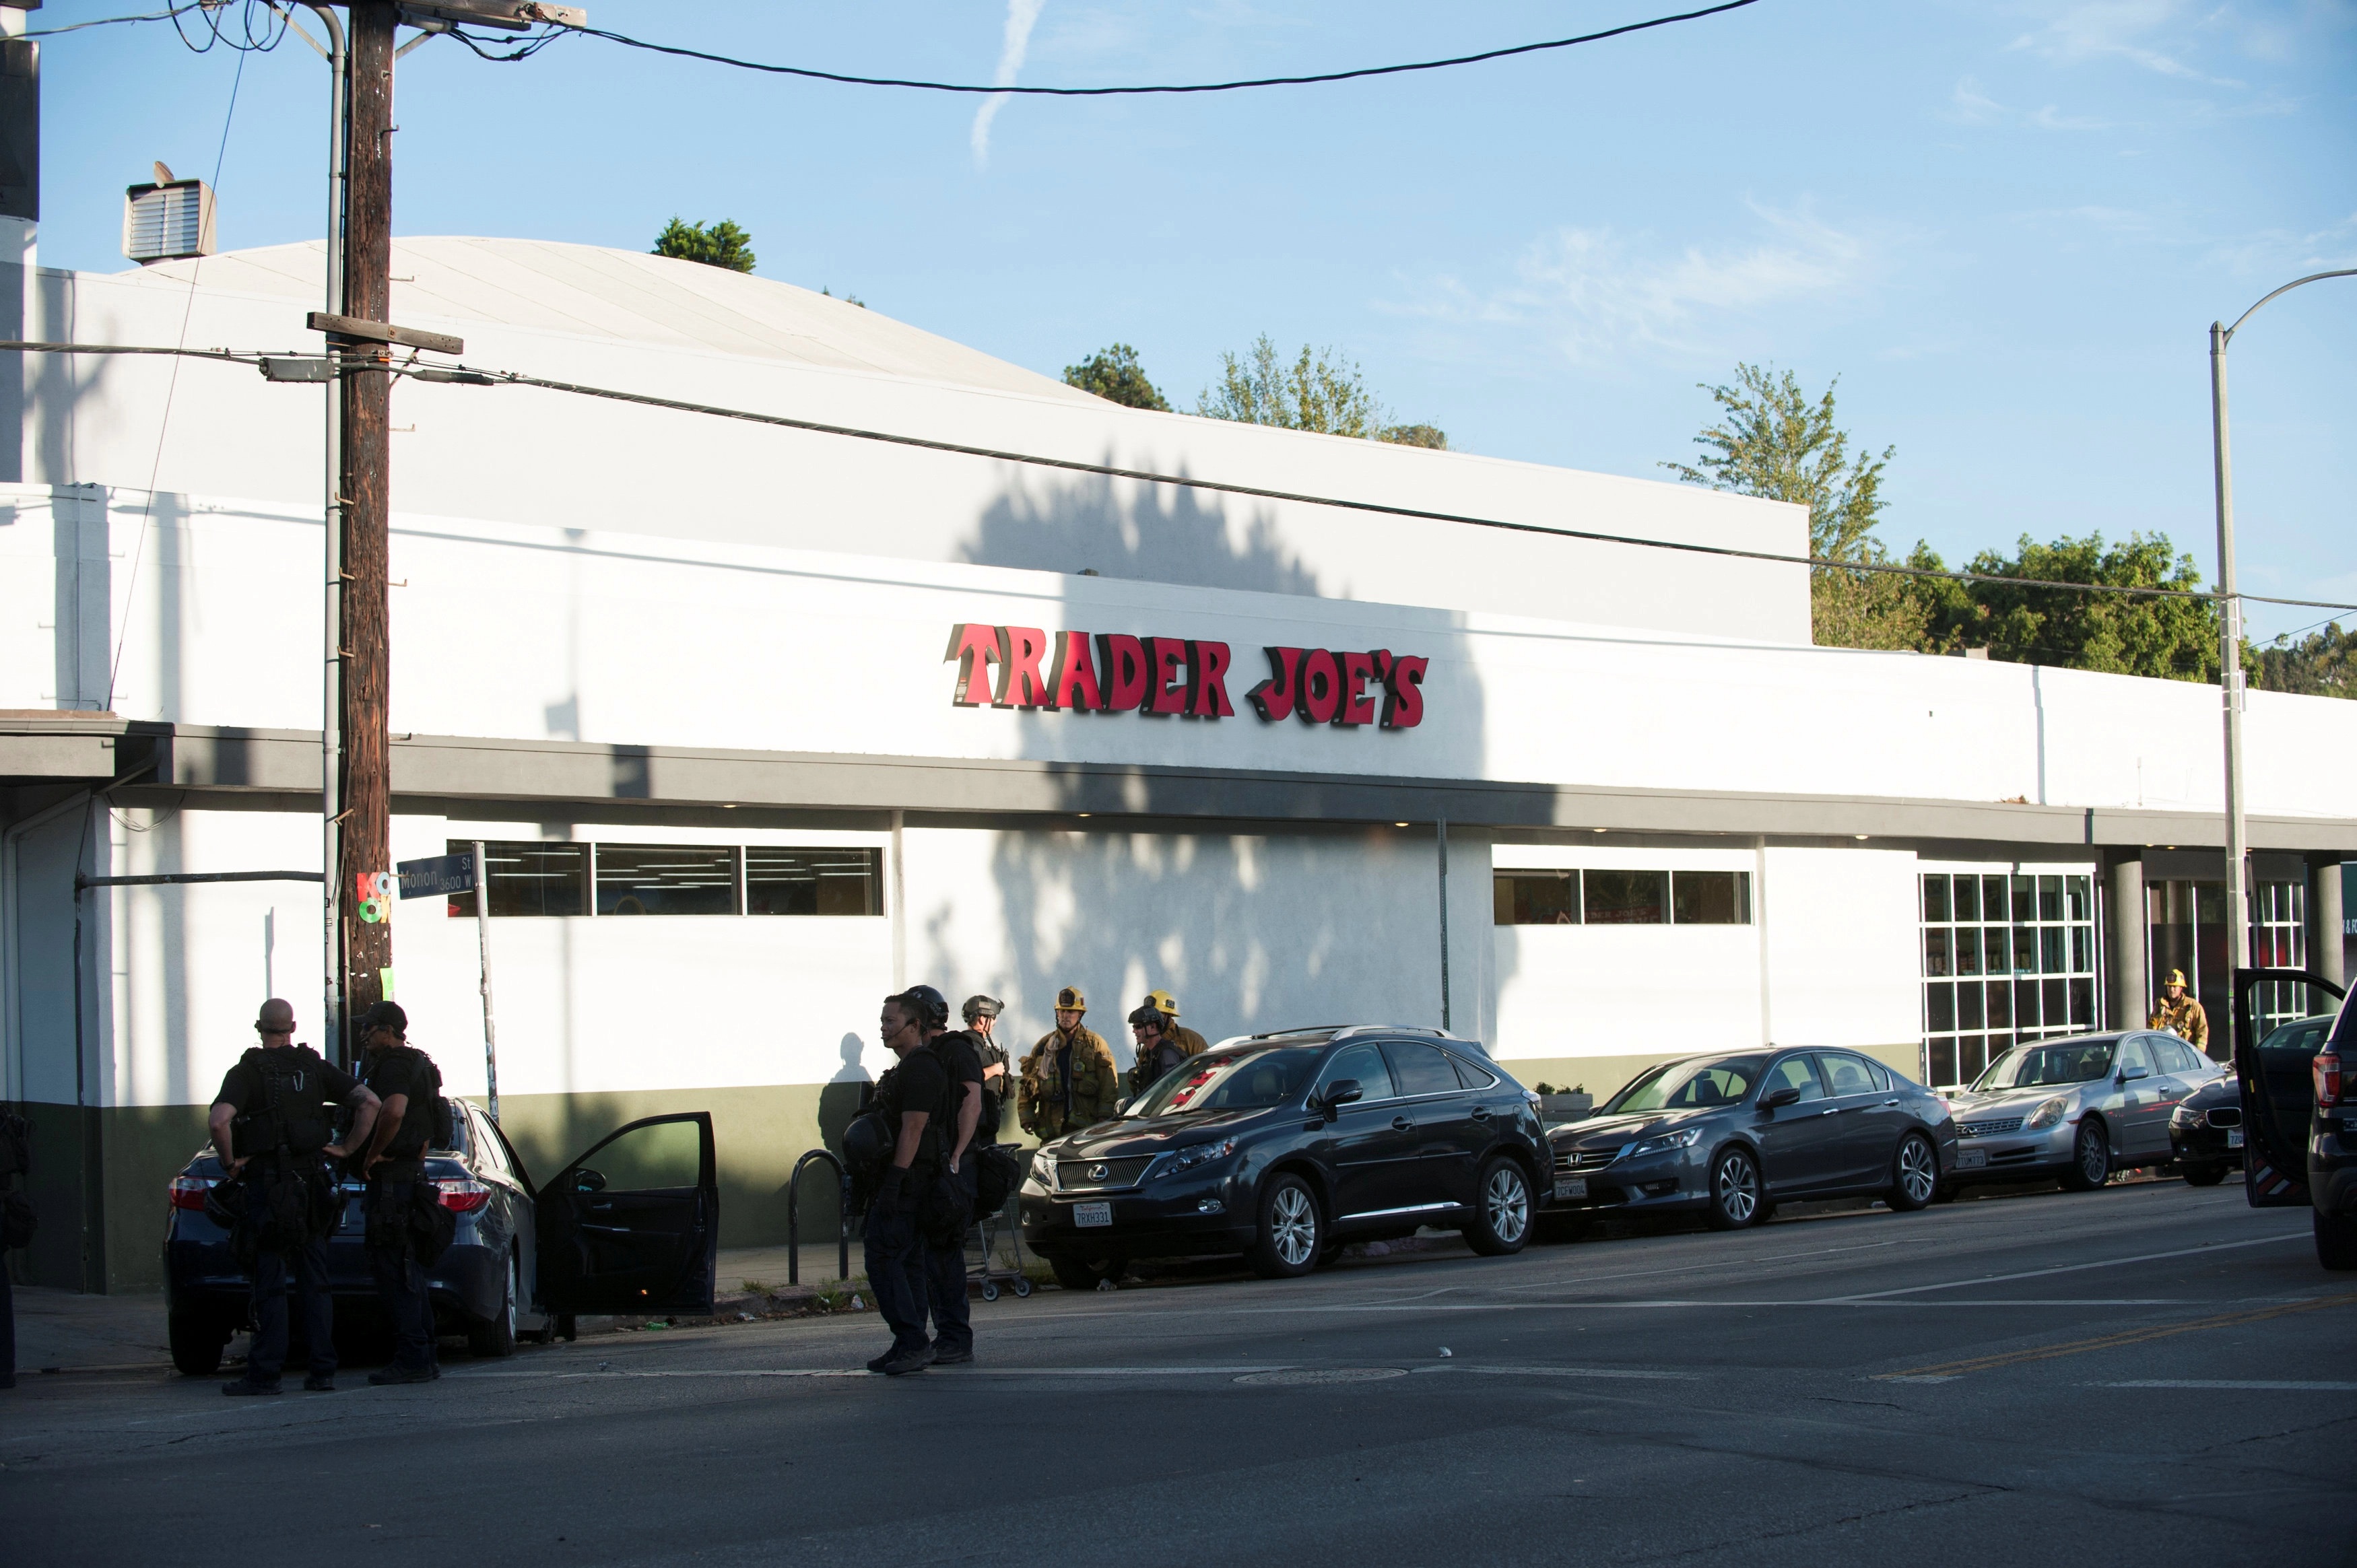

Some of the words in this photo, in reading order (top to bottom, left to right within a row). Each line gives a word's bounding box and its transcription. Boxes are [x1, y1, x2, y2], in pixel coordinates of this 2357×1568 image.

[944, 623, 1234, 716] TRADER
[1245, 646, 1429, 728] JOE'S
[462, 857, 471, 870] St
[401, 871, 437, 889] Monon
[440, 876, 461, 890] 3600
[465, 875, 471, 887] W
[1076, 1211, 1109, 1224] 7RXH331
